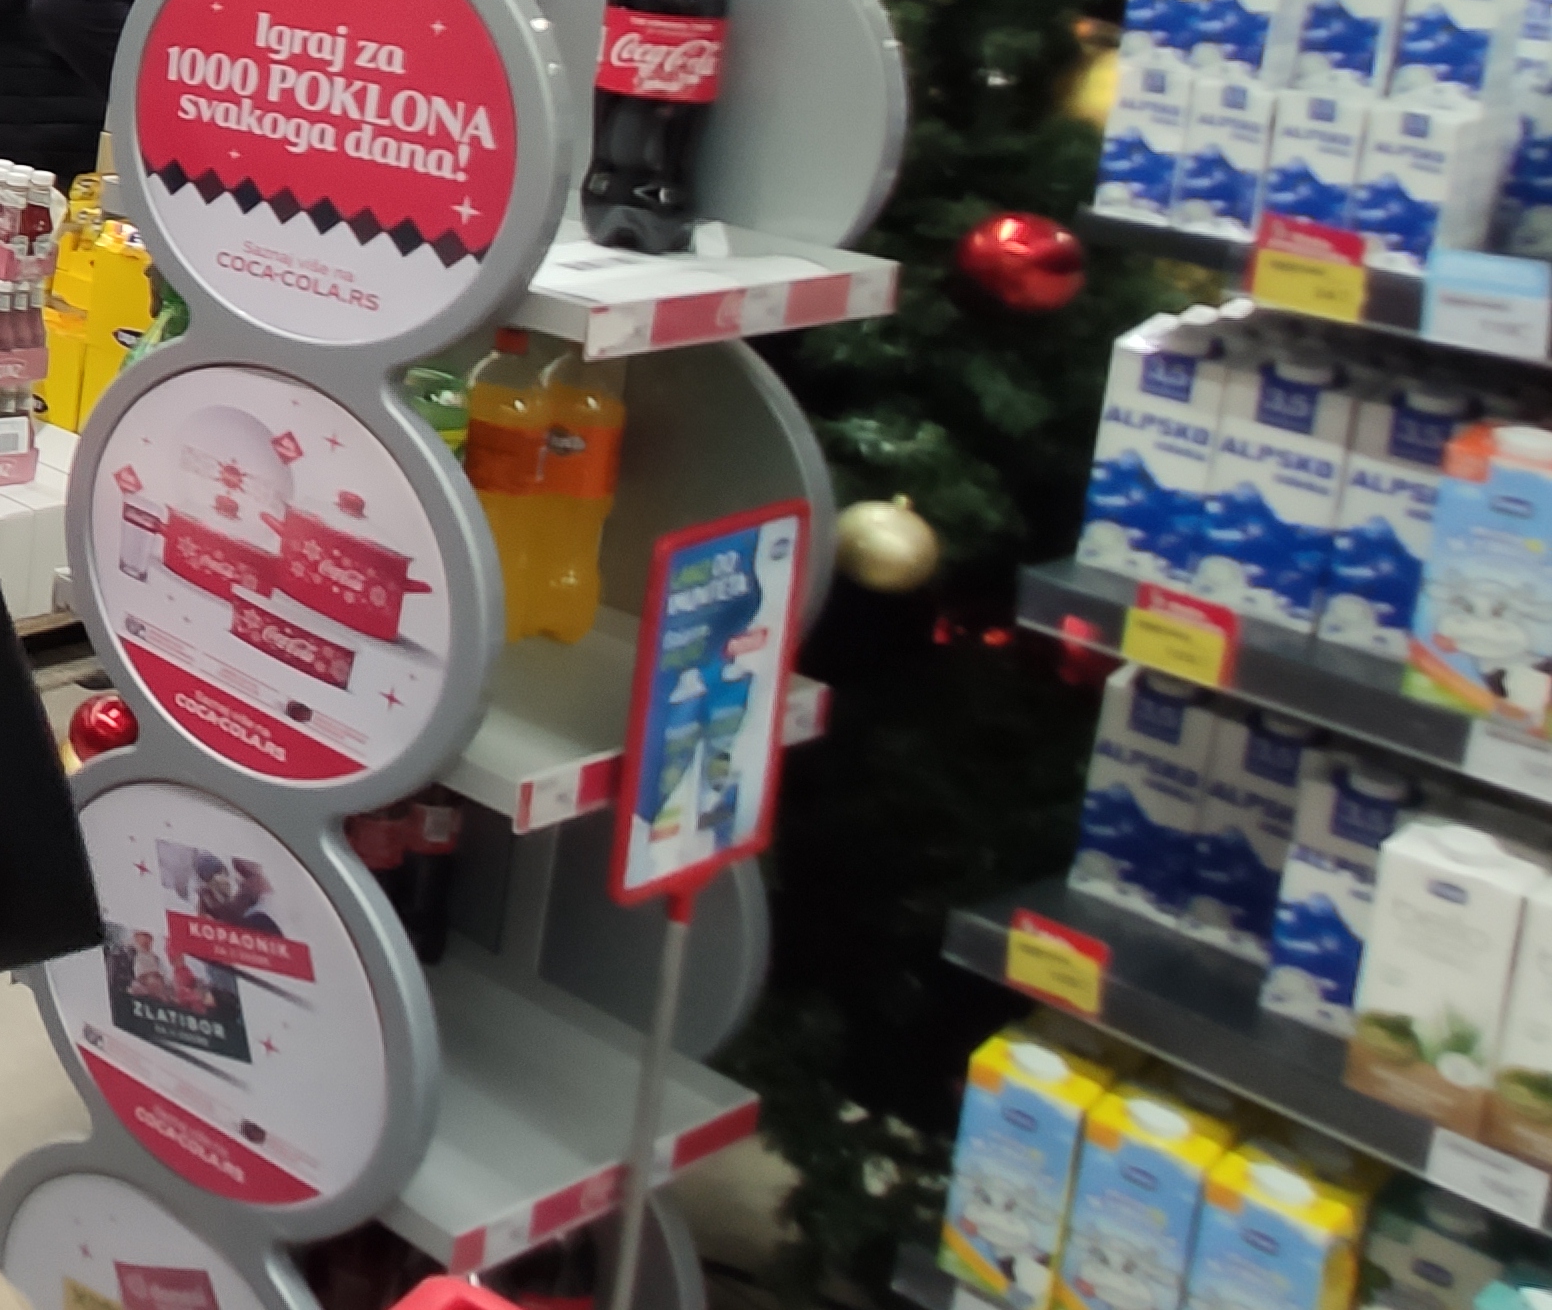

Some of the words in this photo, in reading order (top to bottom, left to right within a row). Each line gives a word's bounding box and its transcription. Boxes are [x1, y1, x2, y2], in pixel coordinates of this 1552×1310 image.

[255, 11, 350, 72] Igraj
[355, 40, 406, 75] za
[166, 45, 259, 97] 1000
[267, 64, 497, 150] POKLONA
[178, 94, 337, 155] svakoga
[345, 123, 471, 182] dana!
[216, 251, 380, 311] COCA-COLA.RS
[132, 1000, 226, 1040] ZLATIBOR
